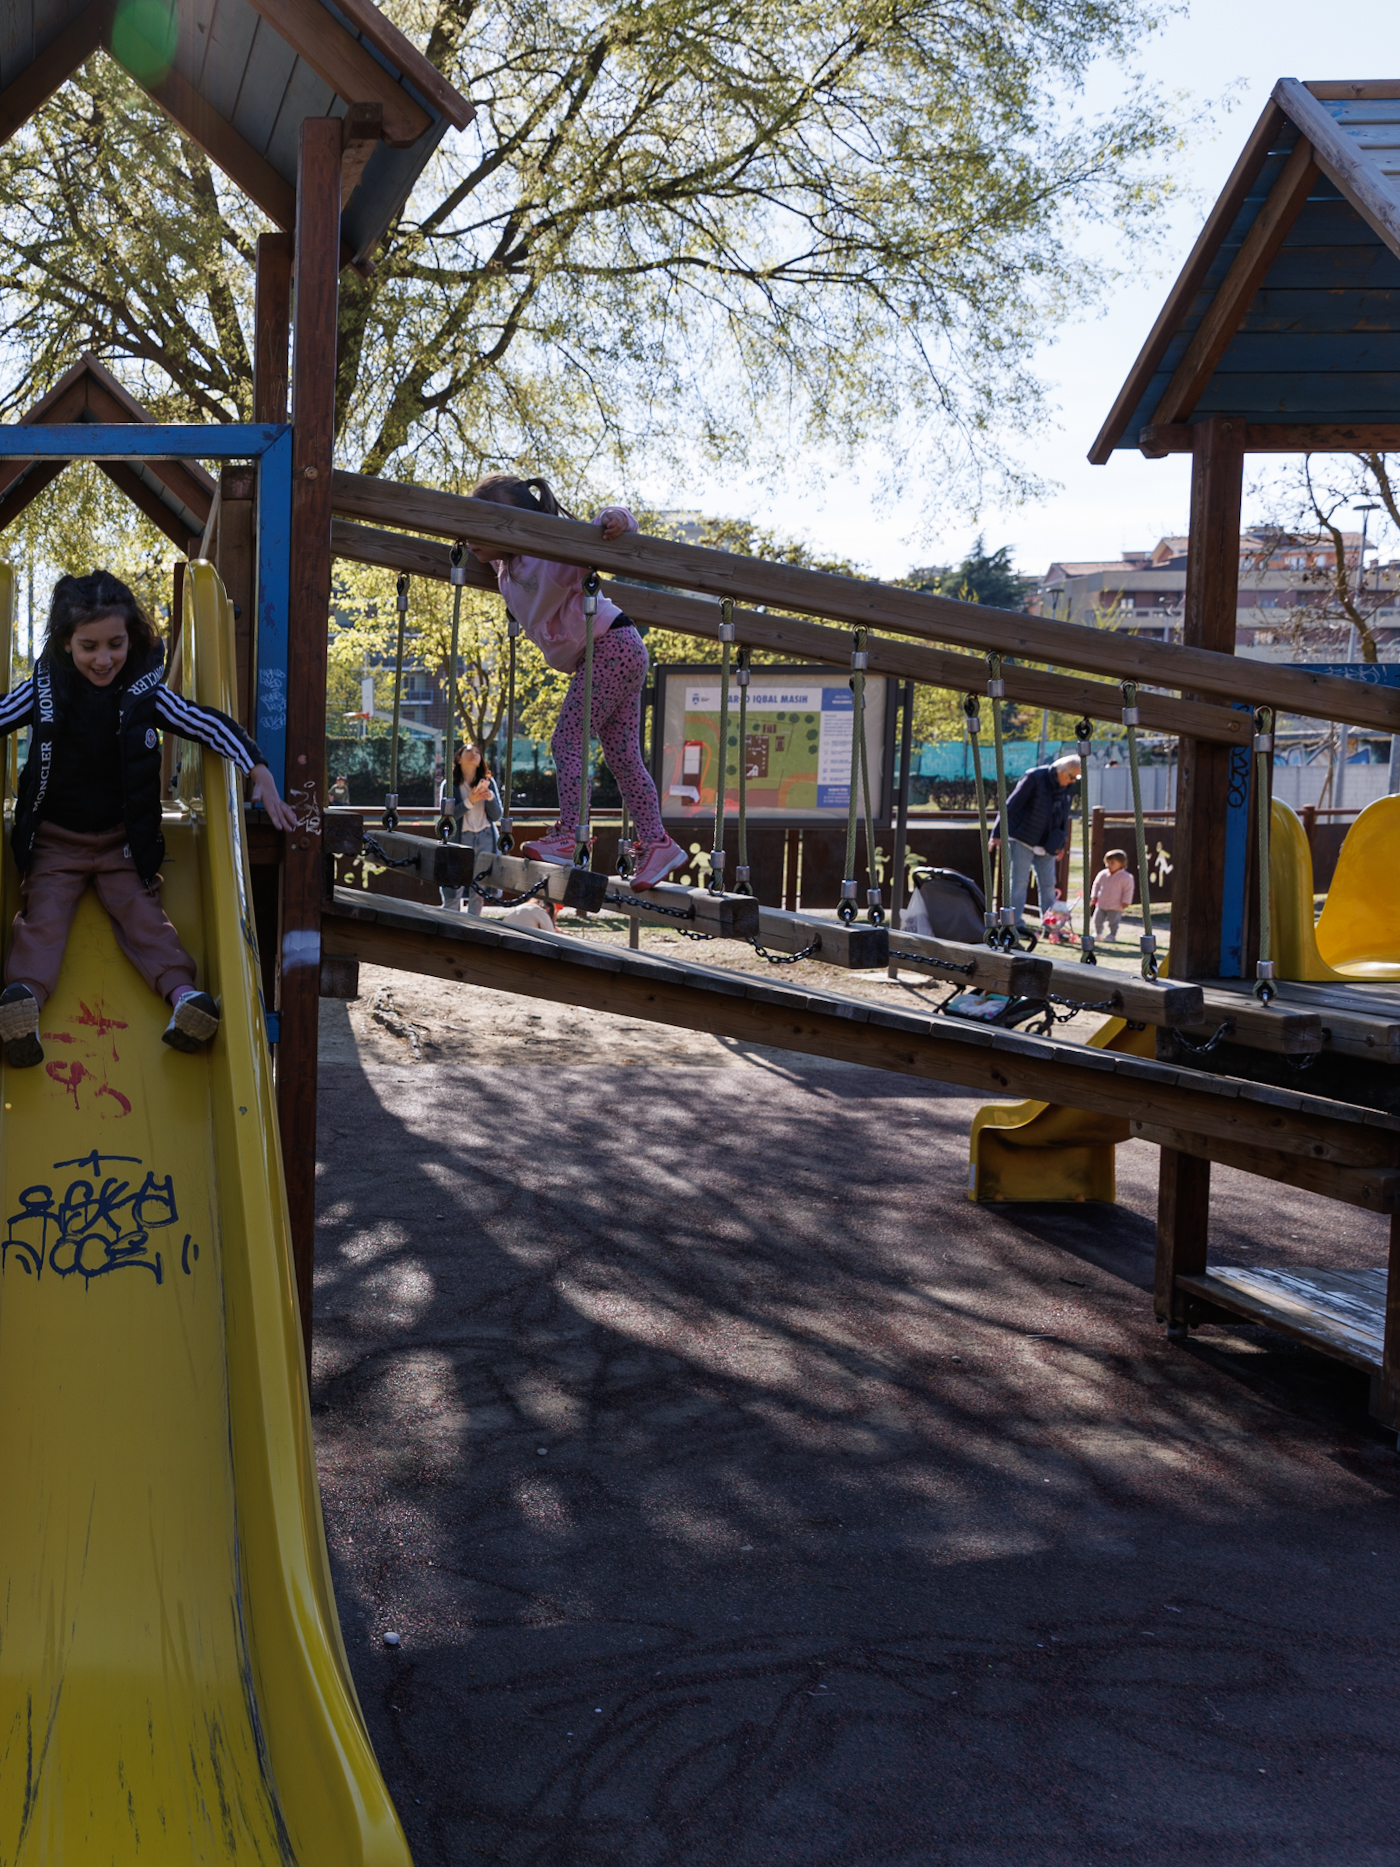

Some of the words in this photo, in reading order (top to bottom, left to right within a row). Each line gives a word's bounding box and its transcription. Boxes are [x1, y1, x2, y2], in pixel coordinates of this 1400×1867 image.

[752, 694, 778, 704] IQBAL
[780, 694, 808, 704] MASIH
[32, 740, 53, 813] MONCLER
